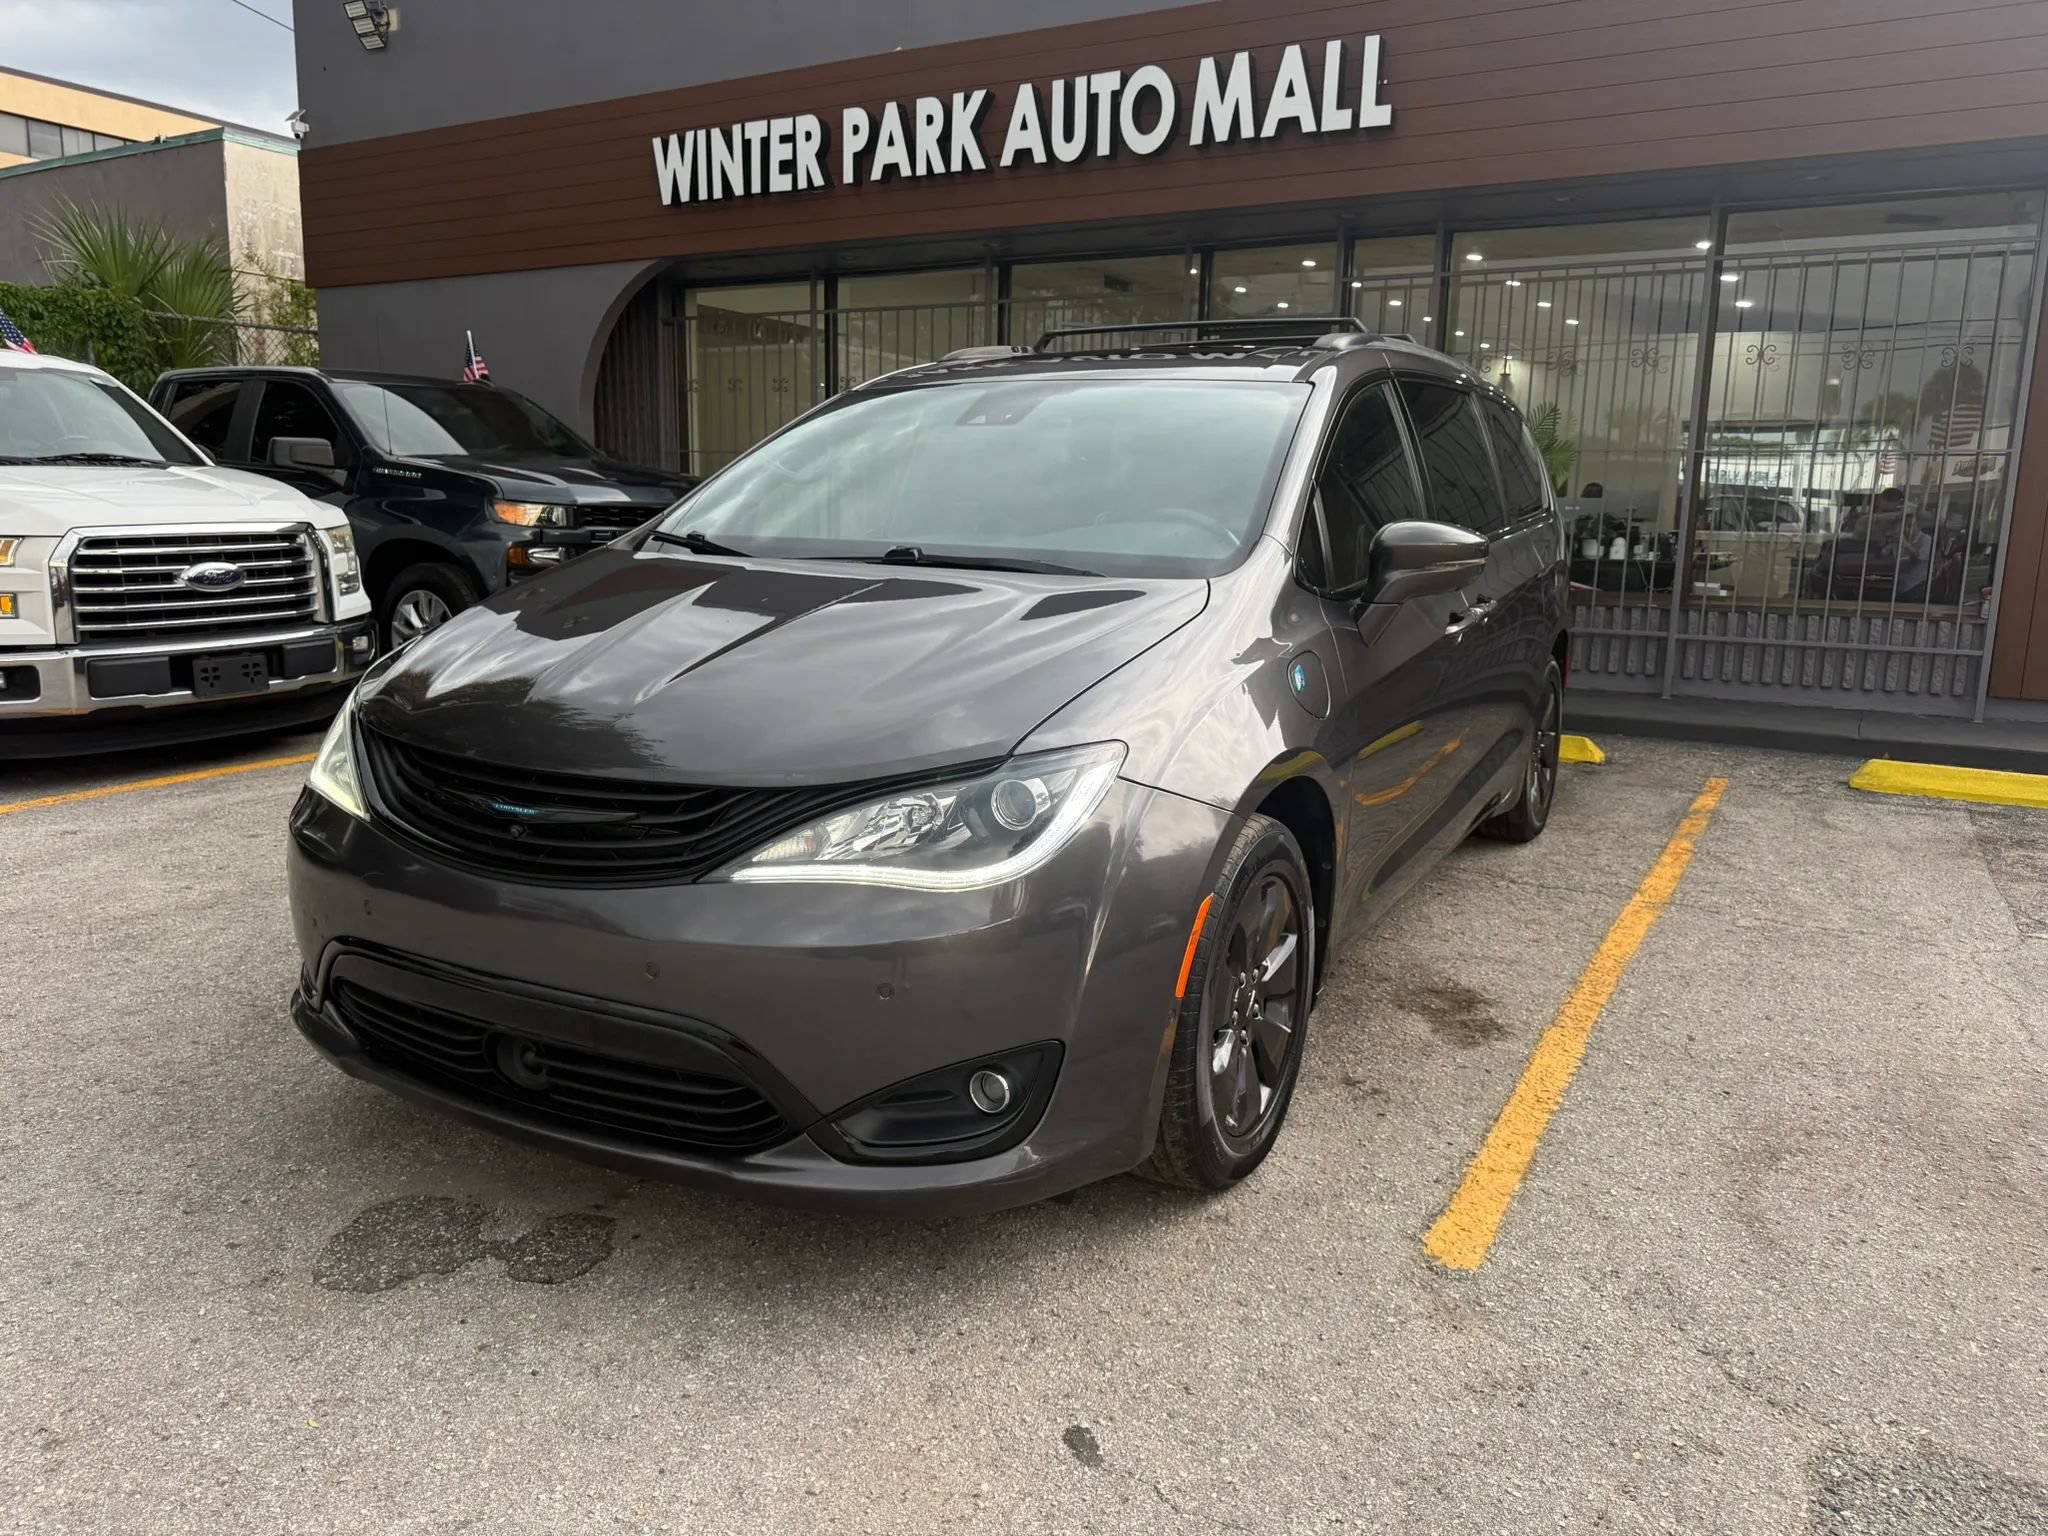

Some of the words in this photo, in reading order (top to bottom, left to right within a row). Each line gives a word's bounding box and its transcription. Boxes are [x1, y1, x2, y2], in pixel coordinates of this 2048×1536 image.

[653, 115, 825, 205] WINTER
[844, 90, 987, 184] PARK
[1000, 66, 1175, 167] AUTO
[1190, 35, 1392, 146] MALL
